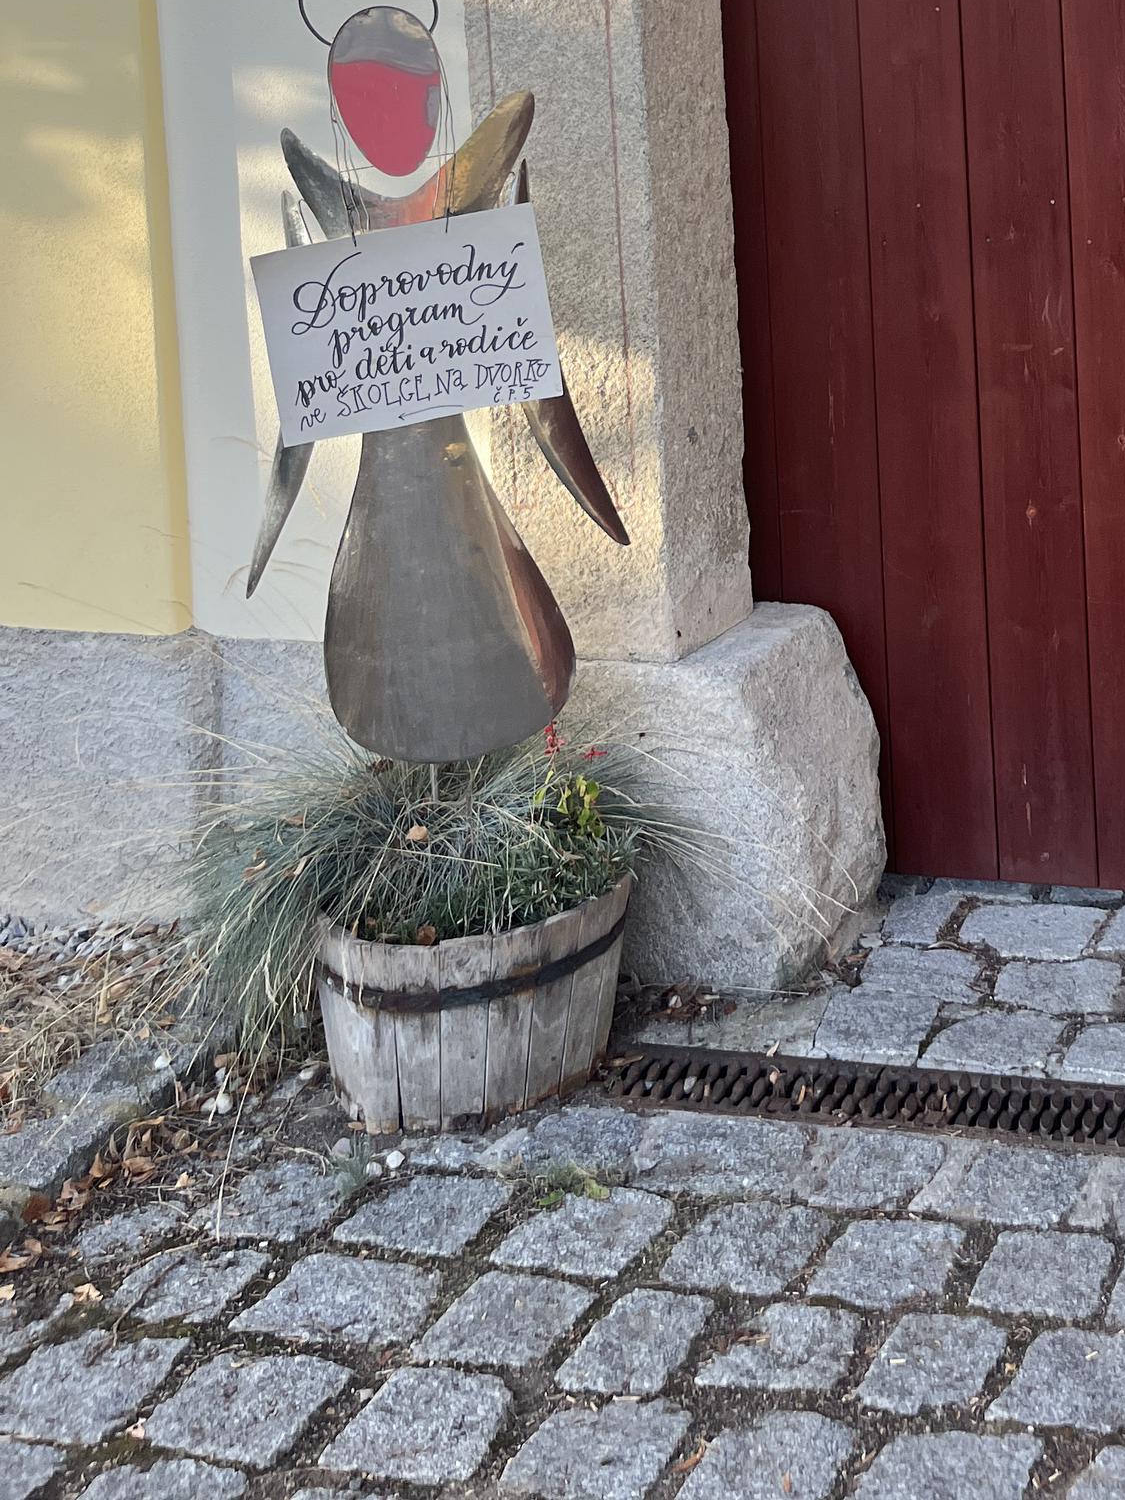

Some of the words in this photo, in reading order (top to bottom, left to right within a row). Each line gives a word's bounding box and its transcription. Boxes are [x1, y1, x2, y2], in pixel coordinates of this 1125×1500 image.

[291, 242, 526, 335] Doprovodný
[295, 368, 346, 408] pro
[355, 341, 416, 381] děti
[419, 345, 436, 364] a
[438, 317, 538, 359] rodiče
[327, 300, 484, 367] program
[300, 405, 328, 431] ve
[473, 359, 552, 389] DVORKU
